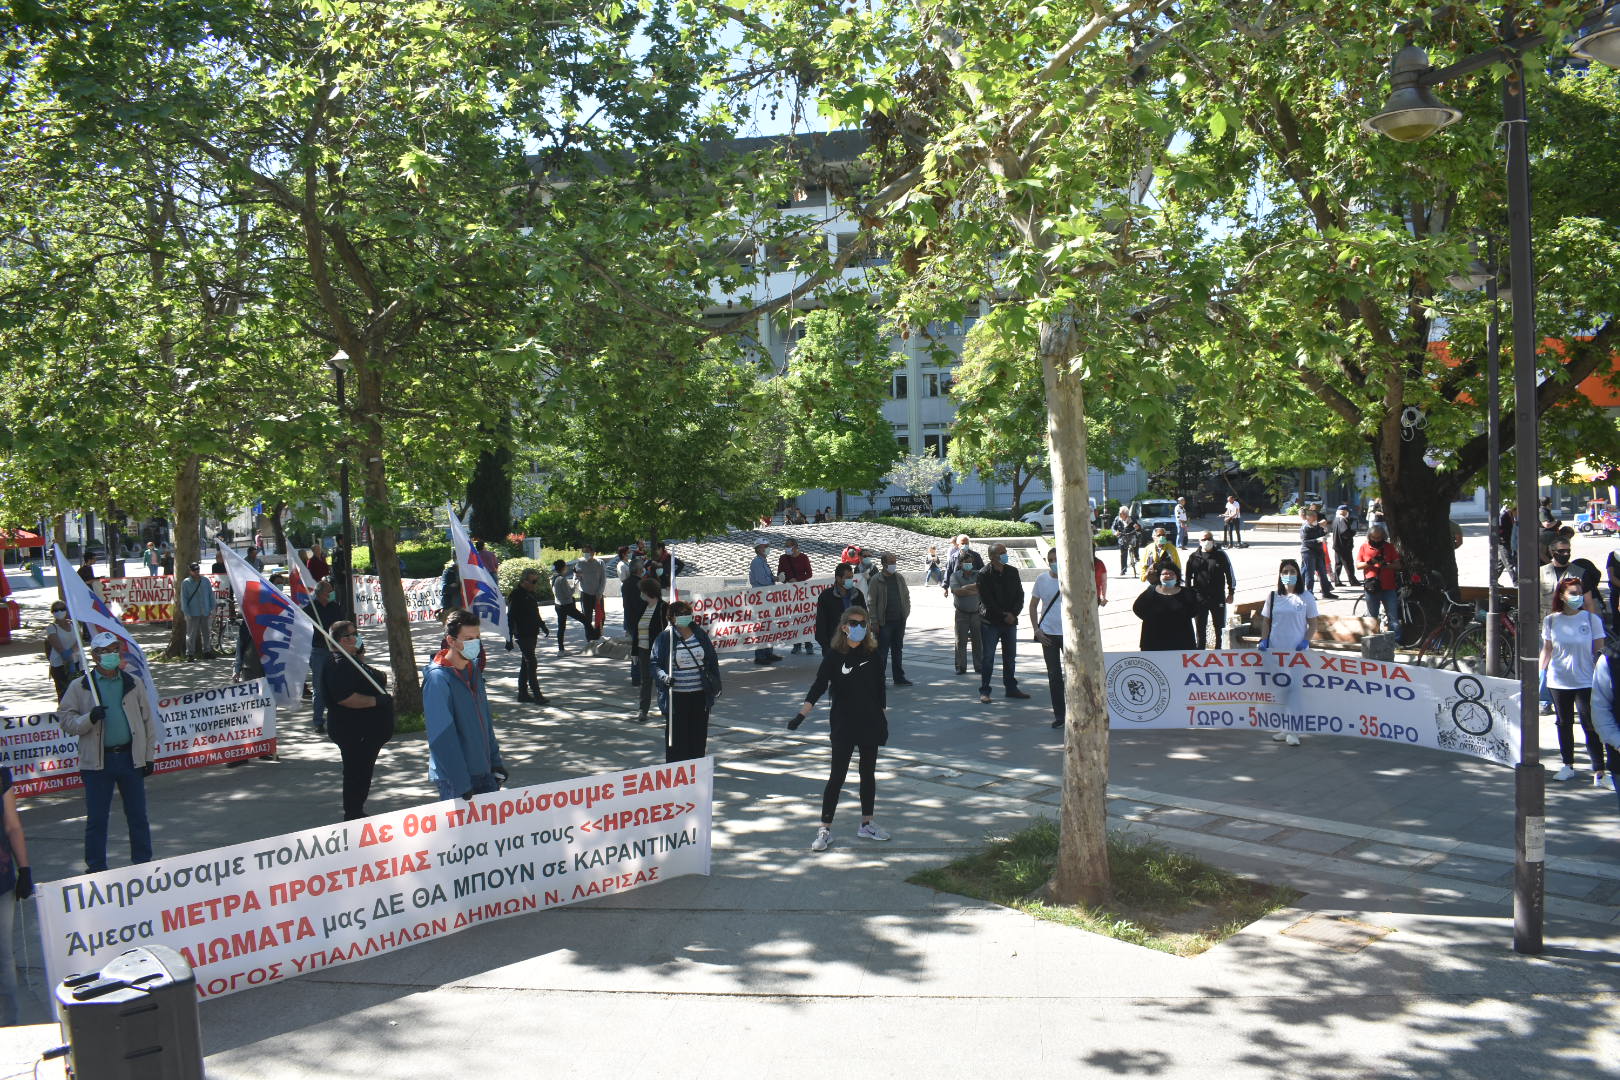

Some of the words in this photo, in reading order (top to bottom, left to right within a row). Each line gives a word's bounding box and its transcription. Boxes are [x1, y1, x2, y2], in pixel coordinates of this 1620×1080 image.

[691, 609, 752, 626] ΒΕΡΝΗΣΗ
[1181, 651, 1265, 668] ΚΑΤΩ
[1272, 652, 1311, 669] ΤΑ
[1319, 655, 1412, 683] ΧΕΡΙΑ
[1184, 672, 1246, 686] ΑΠΟ
[1255, 671, 1292, 687] ΤΟ
[1302, 673, 1415, 701] ΩΡΑΡΙΟ
[1188, 691, 1276, 702] ΔΙΕΚΔΙΚΟΥΜΕ:
[4, 715, 41, 730] ΣΤΟ
[174, 725, 188, 737] ΤΑ
[1186, 706, 1234, 726] 7ΩΡΟ
[1248, 706, 1343, 732] 5ΝΘΗΜΕΡΟ
[1359, 714, 1419, 743] 35ΩΡΟ
[165, 740, 189, 752] ΤΗΣ
[192, 726, 264, 748] ΑΣΦΑΛΙΣΗΣ
[62, 856, 246, 913] Πληρώσαμε
[254, 828, 349, 870] πολλά!
[359, 822, 394, 848] Δε
[403, 813, 436, 837] θα
[446, 783, 615, 828] πληρώσουμε
[622, 764, 696, 796] ΞΑΝΑ!
[65, 920, 154, 956] Άμεσα
[161, 890, 262, 933] ΜΕΤΡΑ
[269, 849, 431, 907] ΠΡΟΣΤΑΣΙΑΣ
[437, 842, 488, 867] τώρα
[495, 835, 524, 857] για
[531, 825, 574, 845] τους
[579, 802, 696, 832] <<ΗΡΩΕΣ>>
[322, 907, 367, 939] μας
[372, 892, 405, 921] ΔΕ
[412, 883, 448, 909] ΘΑ
[453, 862, 535, 899] ΜΠΟΥΝ
[542, 860, 567, 877] σε
[574, 828, 696, 871] ΚΑΡΑΝΤΙΝΑ!
[291, 917, 447, 974] ΥΠΑΛΛΗΛΩΝ
[453, 894, 537, 929] ΔΗΜΩΝ
[544, 889, 565, 906] Ν.
[571, 866, 659, 900] ΛΑΡΙΣΑΣ
